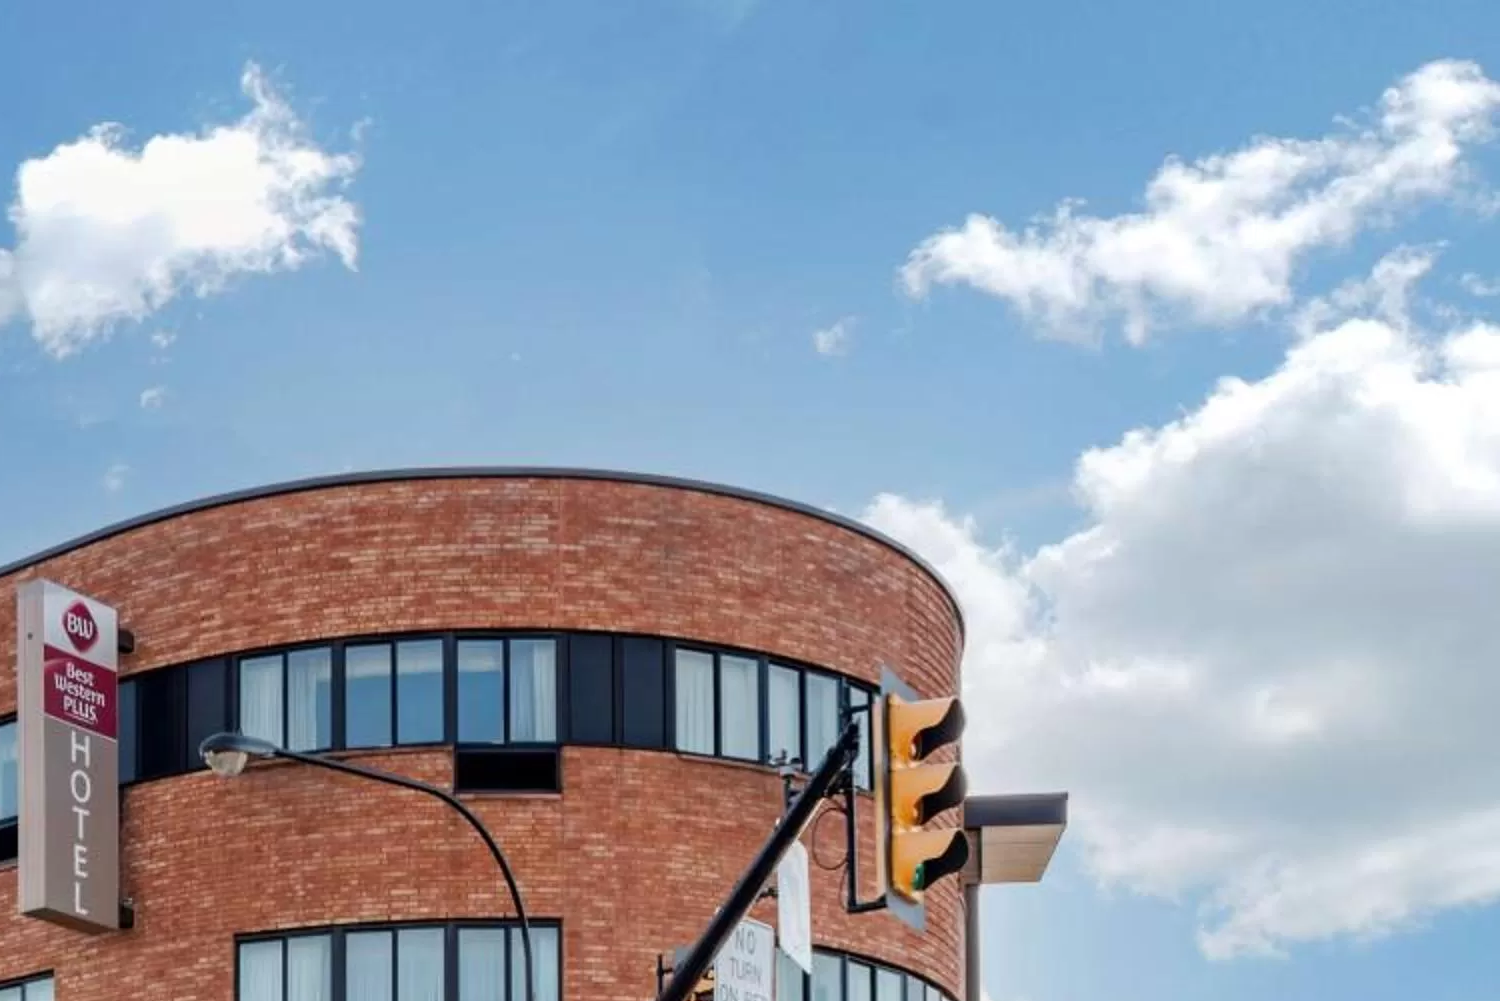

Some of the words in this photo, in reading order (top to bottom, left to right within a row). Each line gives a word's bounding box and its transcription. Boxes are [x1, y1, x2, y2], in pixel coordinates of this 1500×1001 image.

[67, 612, 92, 639] BW
[66, 662, 94, 686] Best
[54, 672, 105, 707] Western
[63, 695, 96, 719] PLUS
[70, 731, 91, 915] HOTEL
[735, 927, 757, 955] NO
[729, 957, 762, 985] TURN
